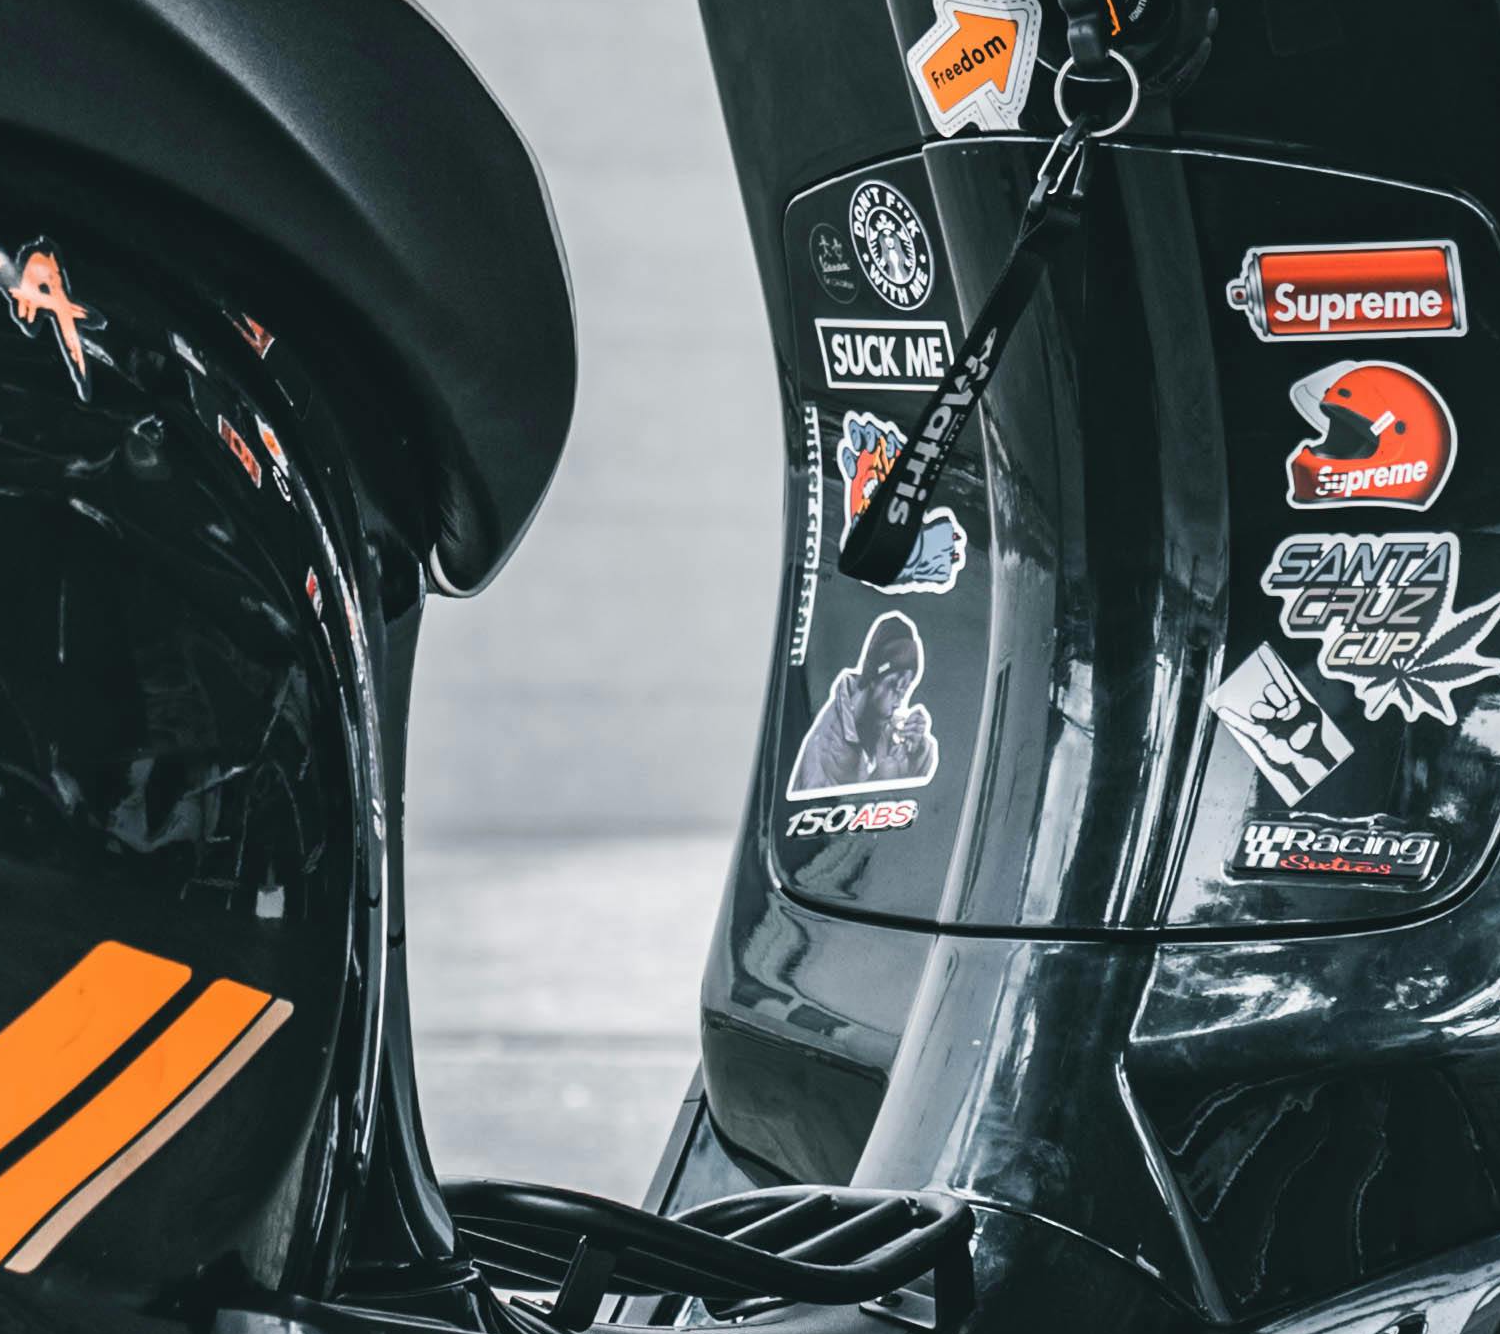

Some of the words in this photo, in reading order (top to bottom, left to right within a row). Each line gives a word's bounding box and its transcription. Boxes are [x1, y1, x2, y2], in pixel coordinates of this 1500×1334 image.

[930, 35, 1008, 89] Freedom
[854, 187, 880, 239] DON'T
[869, 263, 909, 304] WITH
[909, 267, 929, 300] ME
[1273, 283, 1443, 331] Supreme
[831, 333, 900, 377] SUCK
[905, 335, 945, 378] ME
[1315, 460, 1429, 498] Supreme
[1269, 541, 1451, 584] SANTA
[1287, 586, 1440, 626] CRUZ
[1324, 631, 1422, 666] CUP
[1282, 827, 1432, 865] Racing
